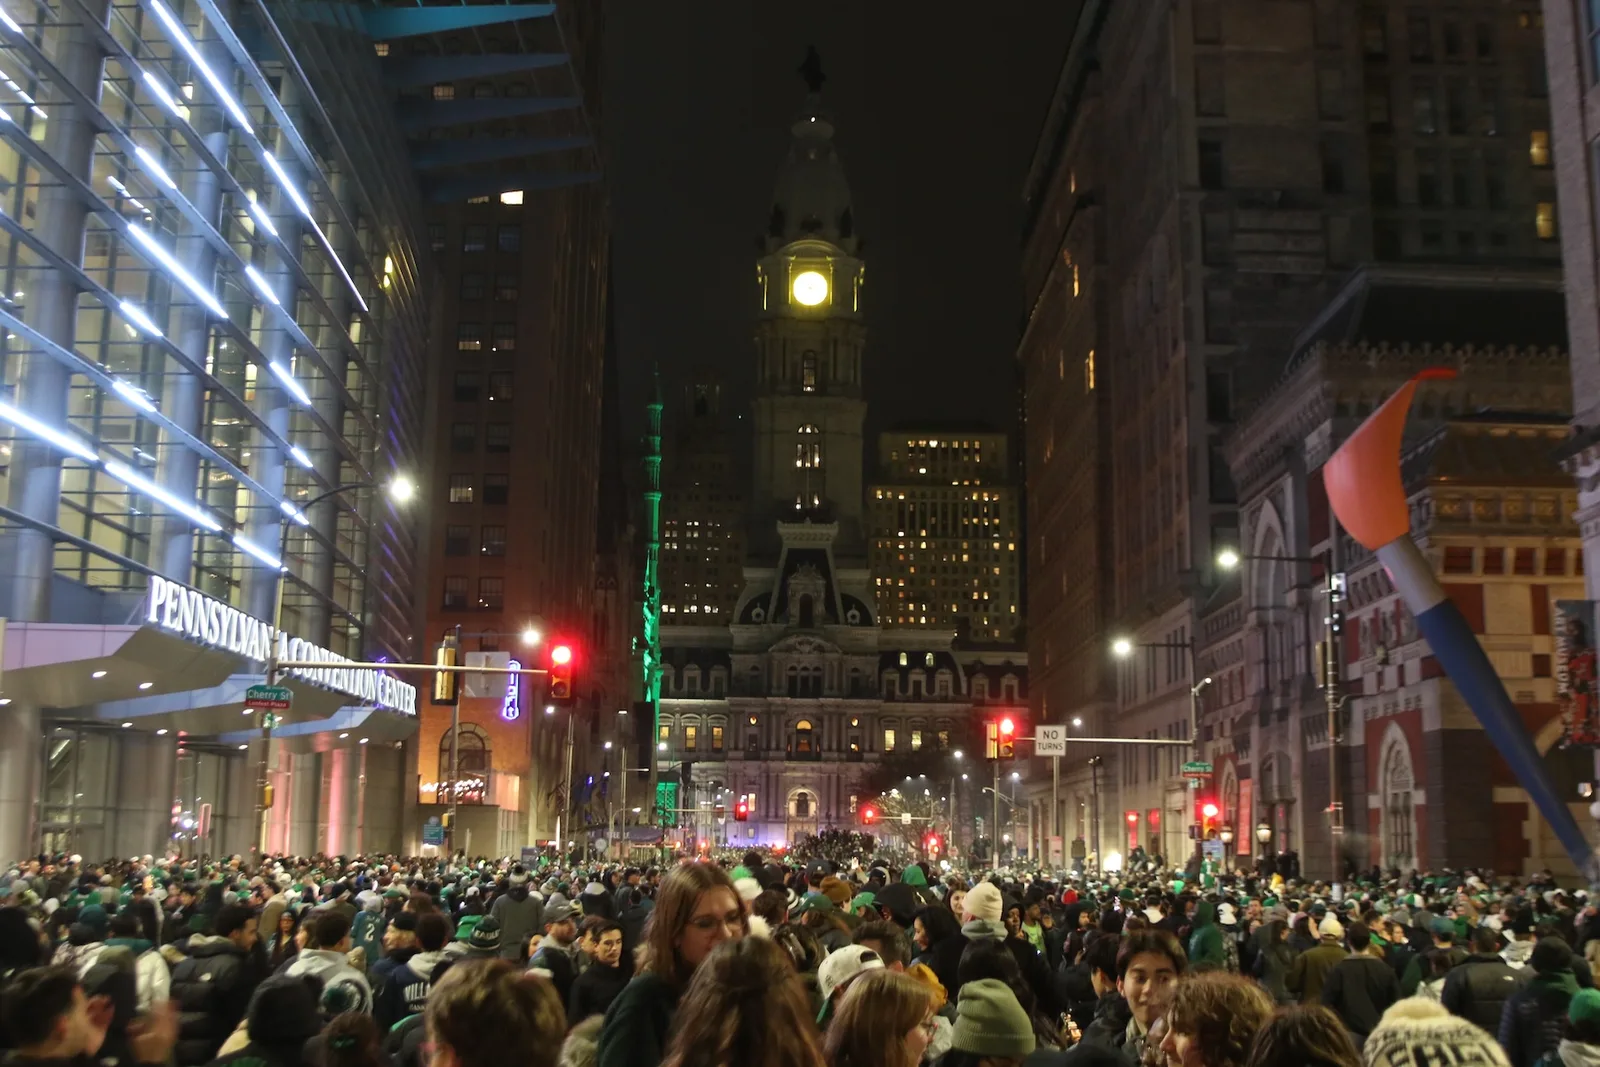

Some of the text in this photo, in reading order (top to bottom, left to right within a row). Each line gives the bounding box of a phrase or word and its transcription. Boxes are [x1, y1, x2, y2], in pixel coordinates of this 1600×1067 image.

[147, 574, 417, 716] PENNSYLVANA CONVENTION CENTER
[1555, 607, 1569, 694] ART MUSEUM
[247, 689, 290, 700] Cherry St
[1043, 730, 1059, 740] NO
[1037, 742, 1064, 751] TURNS
[364, 923, 375, 942] 2
